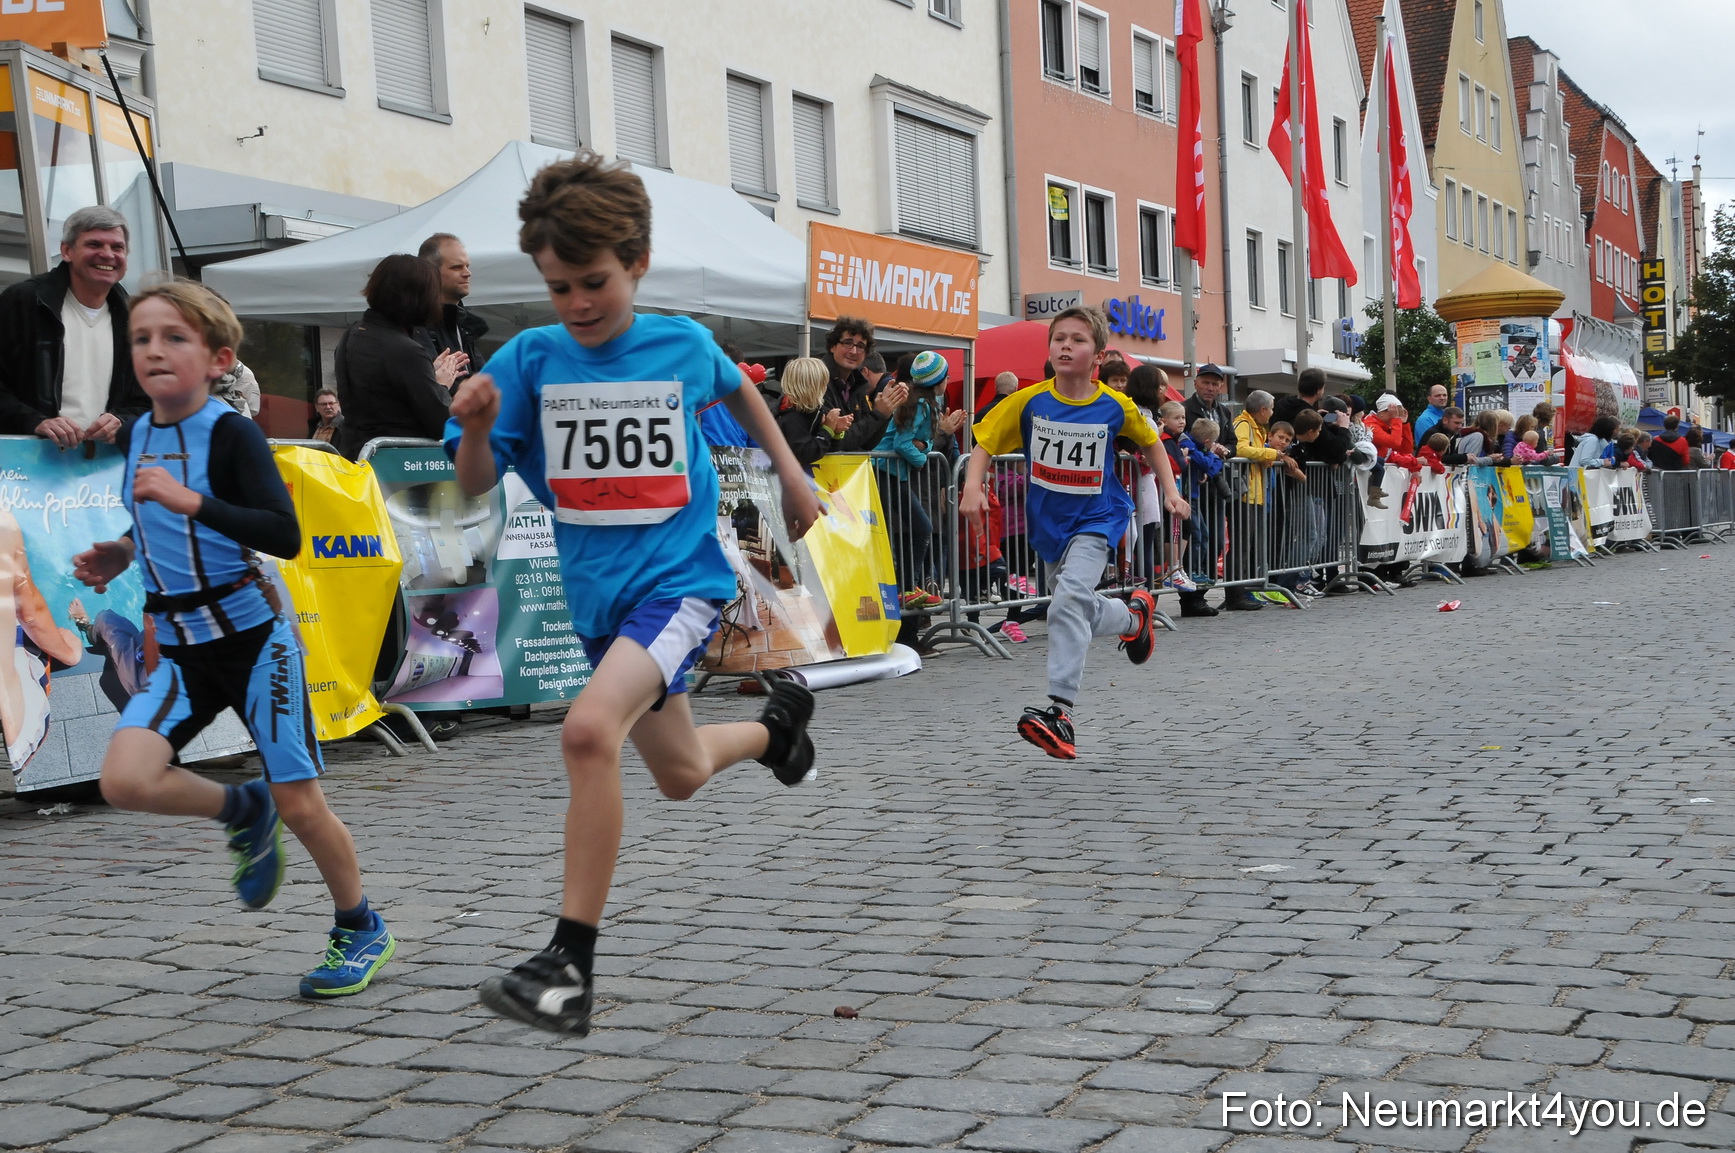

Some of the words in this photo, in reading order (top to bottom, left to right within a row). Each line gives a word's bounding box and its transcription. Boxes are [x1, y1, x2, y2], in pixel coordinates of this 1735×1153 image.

[816, 250, 971, 316] RUNMARKT.DE
[1108, 294, 1167, 341] sutor
[1642, 261, 1666, 376] HOTEL
[543, 399, 585, 412] PARTL
[589, 396, 660, 410] Neumarkt
[1033, 423, 1056, 436] PARTL
[1057, 429, 1095, 438] Neumarkt
[555, 417, 674, 471] 7565
[1037, 436, 1097, 467] 7141
[403, 460, 423, 471] Seit
[424, 460, 445, 471] 1965
[446, 460, 455, 471] in
[728, 472, 743, 483] und
[1039, 467, 1093, 485] Maximilian
[312, 534, 385, 559] KANN
[515, 573, 542, 585] 92318
[518, 588, 540, 599] Tel.:
[519, 664, 559, 678] Komplette
